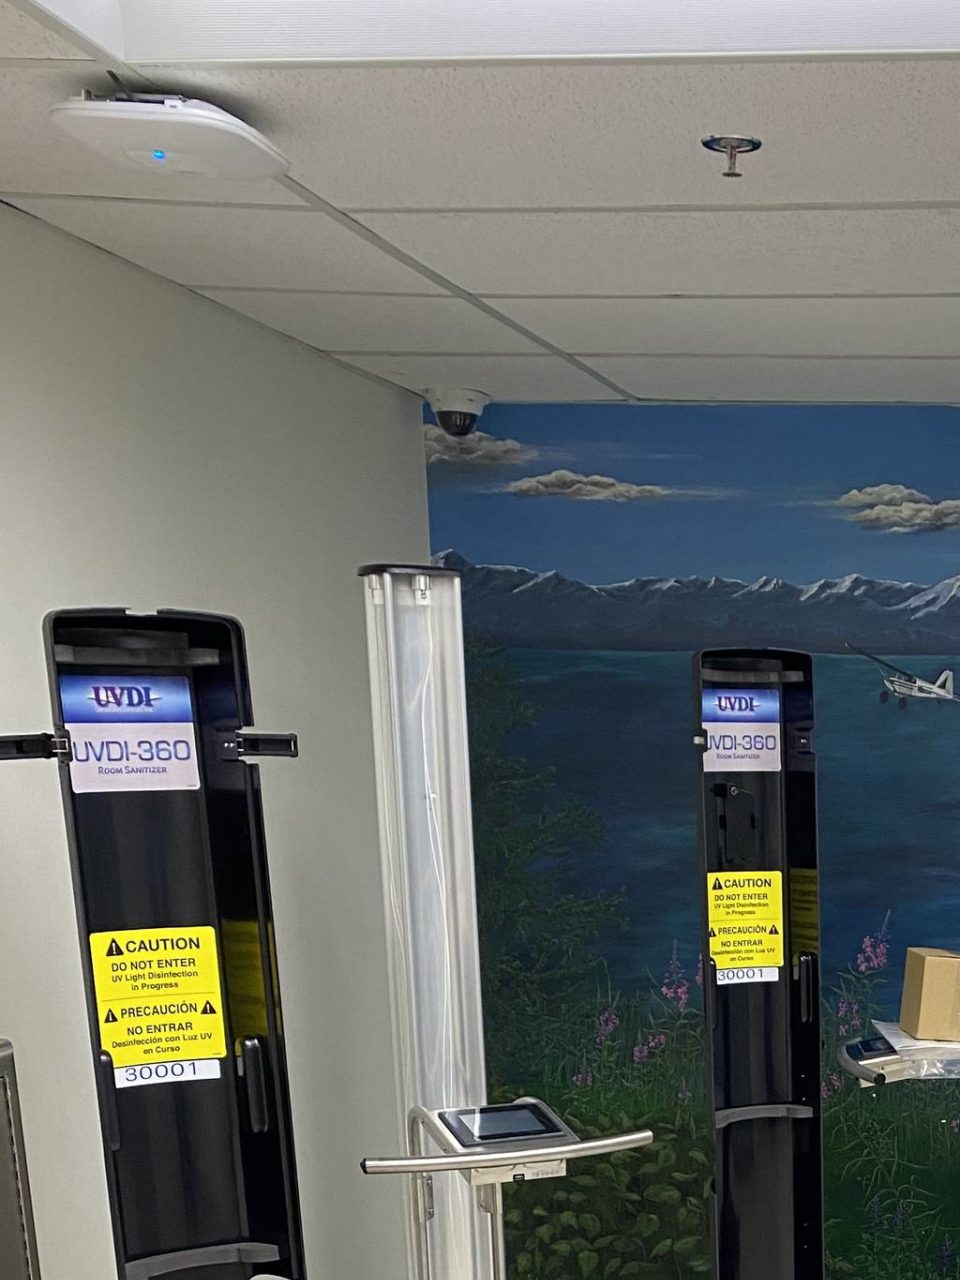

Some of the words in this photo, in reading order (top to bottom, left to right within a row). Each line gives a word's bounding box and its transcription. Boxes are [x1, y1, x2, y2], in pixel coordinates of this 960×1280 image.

[92, 686, 154, 708] UVDI
[716, 696, 755, 712] UVDI
[72, 739, 192, 763] UVDI-360
[724, 878, 772, 888] CAUTION
[718, 925, 767, 935] PRECAUCIÓN
[126, 936, 201, 953] CAUTION
[720, 940, 731, 948] NO
[111, 961, 127, 972] DO
[130, 960, 153, 971] NOT
[157, 958, 196, 968] ENTER
[111, 975, 123, 983] UV
[125, 972, 146, 982] Light
[147, 970, 198, 980] Disinfection
[718, 969, 763, 981] 30001
[131, 983, 139, 991] in
[141, 981, 179, 991] Progress
[120, 1000, 198, 1019] PRECAUCIÓN
[127, 1026, 143, 1036] NO
[147, 1022, 193, 1034] ENTRAR
[111, 1036, 162, 1049] Desinfección
[165, 1036, 180, 1044] con
[182, 1033, 198, 1043] Luz
[200, 1032, 213, 1041] UV
[155, 1045, 181, 1055] Curso
[125, 1061, 197, 1082] 30001
